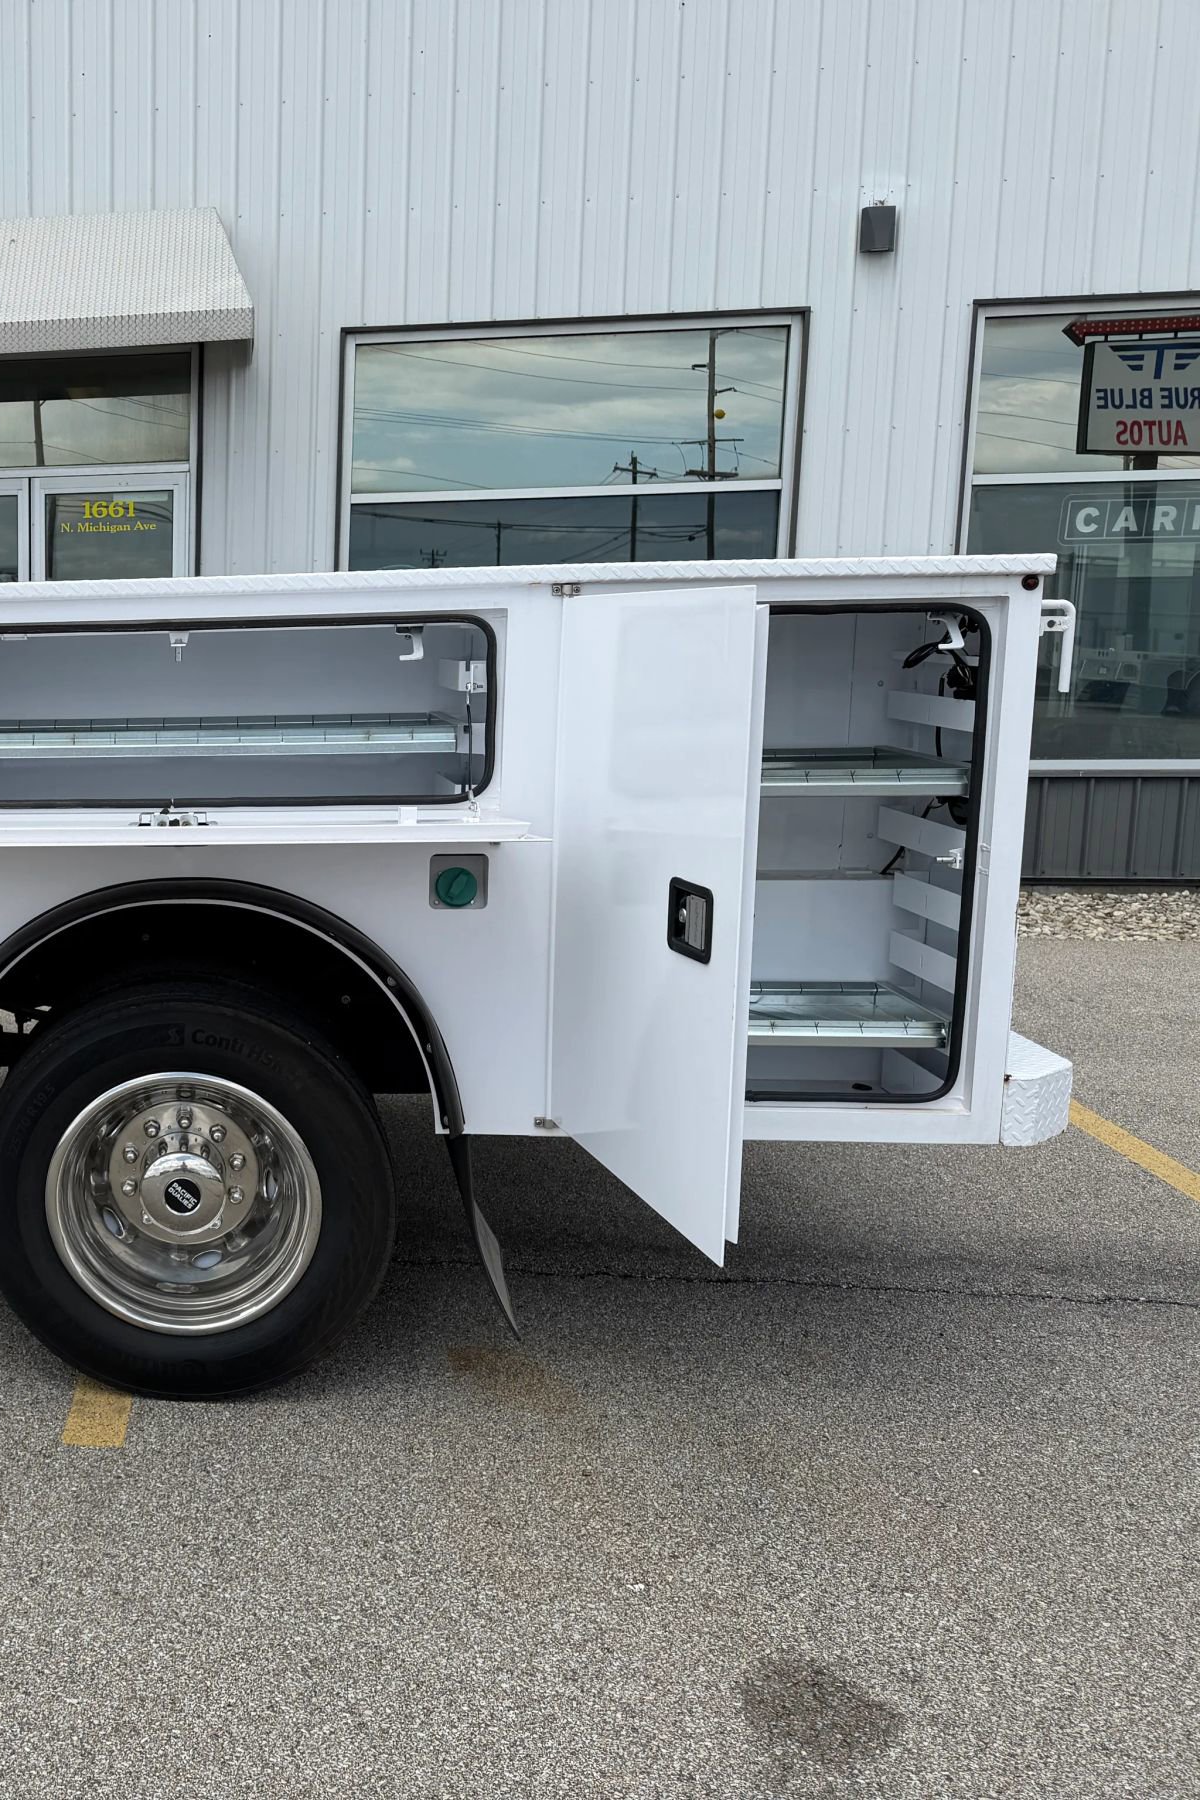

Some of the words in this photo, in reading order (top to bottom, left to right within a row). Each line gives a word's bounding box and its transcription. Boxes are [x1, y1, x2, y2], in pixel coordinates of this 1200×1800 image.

[82, 500, 135, 519] 1661
[60, 523, 74, 533] N.
[77, 521, 131, 534] Michigan
[133, 520, 157, 531] Ave
[191, 1028, 245, 1055] Conti
[168, 1187, 193, 1209] DUALIES
[172, 1182, 197, 1205] PACIFIC
